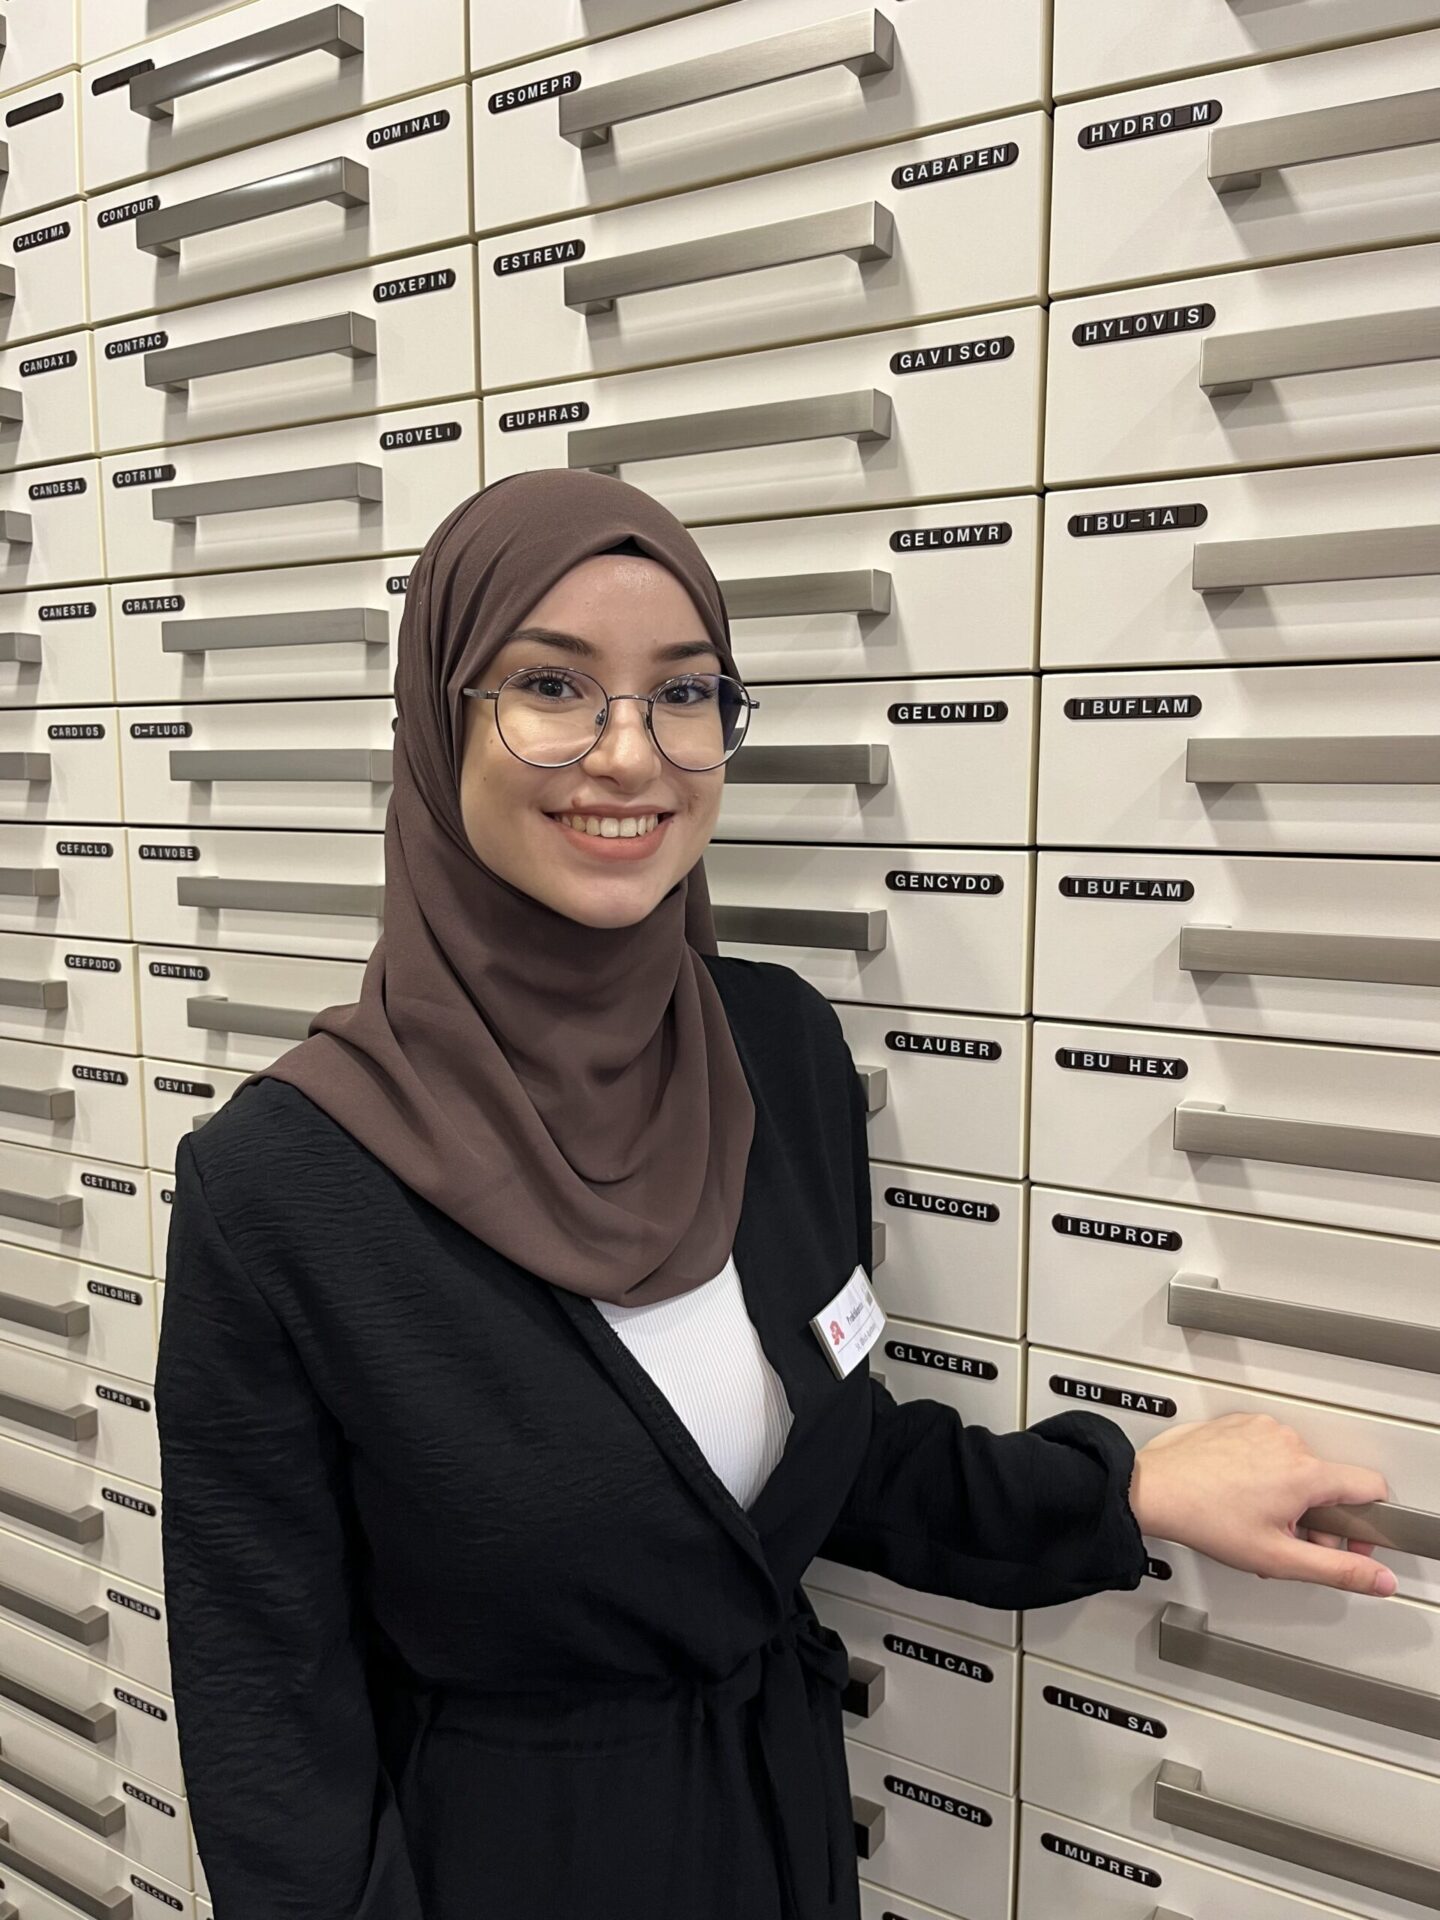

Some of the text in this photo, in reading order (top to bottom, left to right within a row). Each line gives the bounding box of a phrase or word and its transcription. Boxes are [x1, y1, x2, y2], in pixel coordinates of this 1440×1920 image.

[495, 75, 571, 109] ESOMEPR
[1091, 103, 1209, 143] HYDRO M
[902, 147, 1005, 183] GABAPEN
[101, 198, 154, 223] CONTOUR
[17, 225, 65, 248] CALCIMA
[500, 243, 575, 271] ESTREVA
[379, 272, 447, 298] DOXEPIN
[1085, 307, 1199, 341] HYLOVIS
[109, 334, 162, 355] CONTRAC
[899, 341, 1001, 369] GAVISCO
[23, 353, 70, 373] CANDAXI
[506, 405, 580, 428] EUPHRAS
[116, 467, 163, 485] COTRIM
[32, 480, 81, 497] CANDESA
[1083, 509, 1175, 532] IBU-1A
[899, 525, 999, 548] GELOMYR
[41, 604, 90, 619] CANESTE
[125, 597, 179, 612] CRATAEG
[897, 703, 995, 721] GELONID
[1080, 697, 1189, 717] IBUFLAM
[51, 725, 99, 738] CARDIOS
[134, 723, 186, 737] D-FLUOR
[59, 842, 108, 856] CEFACLO
[142, 846, 194, 860] DAIVOBE
[895, 873, 991, 892] GENCYDO
[1074, 879, 1181, 898] IBUFLAM
[68, 956, 116, 971] CEFPODO
[153, 963, 203, 979] DENTINO
[895, 1035, 989, 1057] GLAUBER
[75, 1067, 123, 1083] CELESTA
[1071, 1052, 1174, 1076] IBU HEX
[158, 1079, 193, 1093] DEVIT
[84, 1175, 131, 1193] CETIRIZ
[894, 1191, 987, 1219] GLUCOCH
[1067, 1218, 1168, 1246] IBUPROF
[90, 1283, 137, 1303] CHLORHE
[894, 1345, 983, 1375] GLYCERI
[1063, 1380, 1163, 1413] IBU RAT
[893, 1639, 983, 1679] HALICAR
[1057, 1693, 1154, 1735] ILON SA
[893, 1781, 982, 1823] HANDSCH
[1055, 1840, 1150, 1883] IMUPRET
